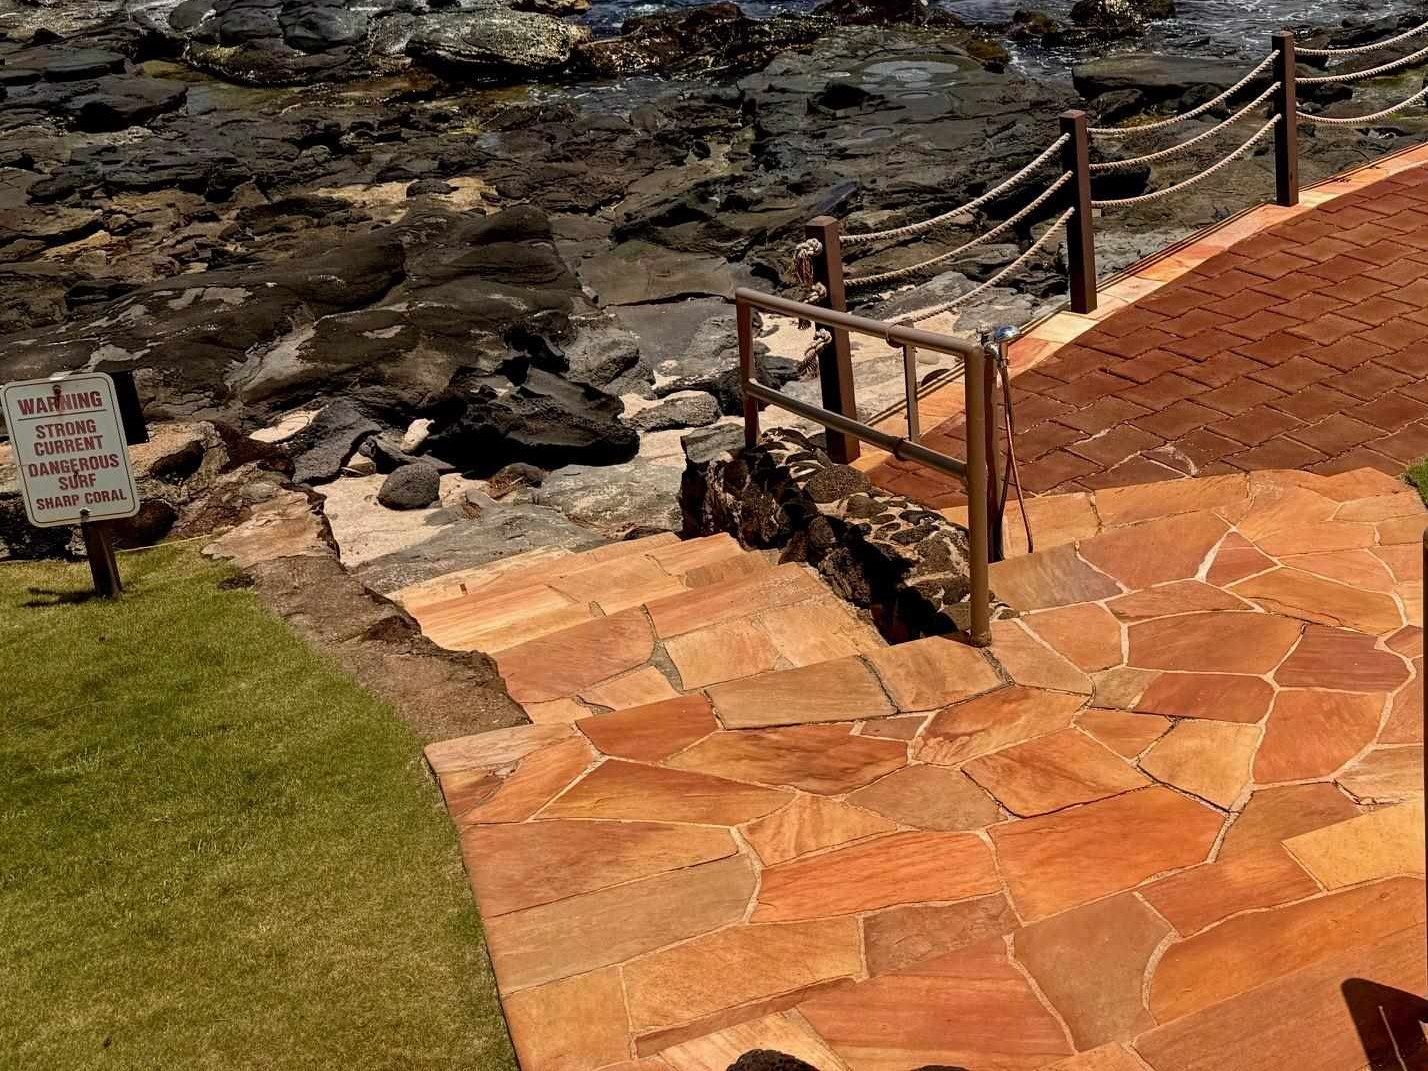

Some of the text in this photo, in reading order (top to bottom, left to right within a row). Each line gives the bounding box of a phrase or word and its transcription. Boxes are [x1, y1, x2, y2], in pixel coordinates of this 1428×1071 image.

[17, 391, 103, 416] WARNING
[35, 419, 97, 439] STRONG
[34, 435, 104, 456] CURRENT
[28, 454, 120, 478] DANGEROUS
[58, 473, 97, 491] SURF
[36, 488, 128, 511] SHARP CORAL
